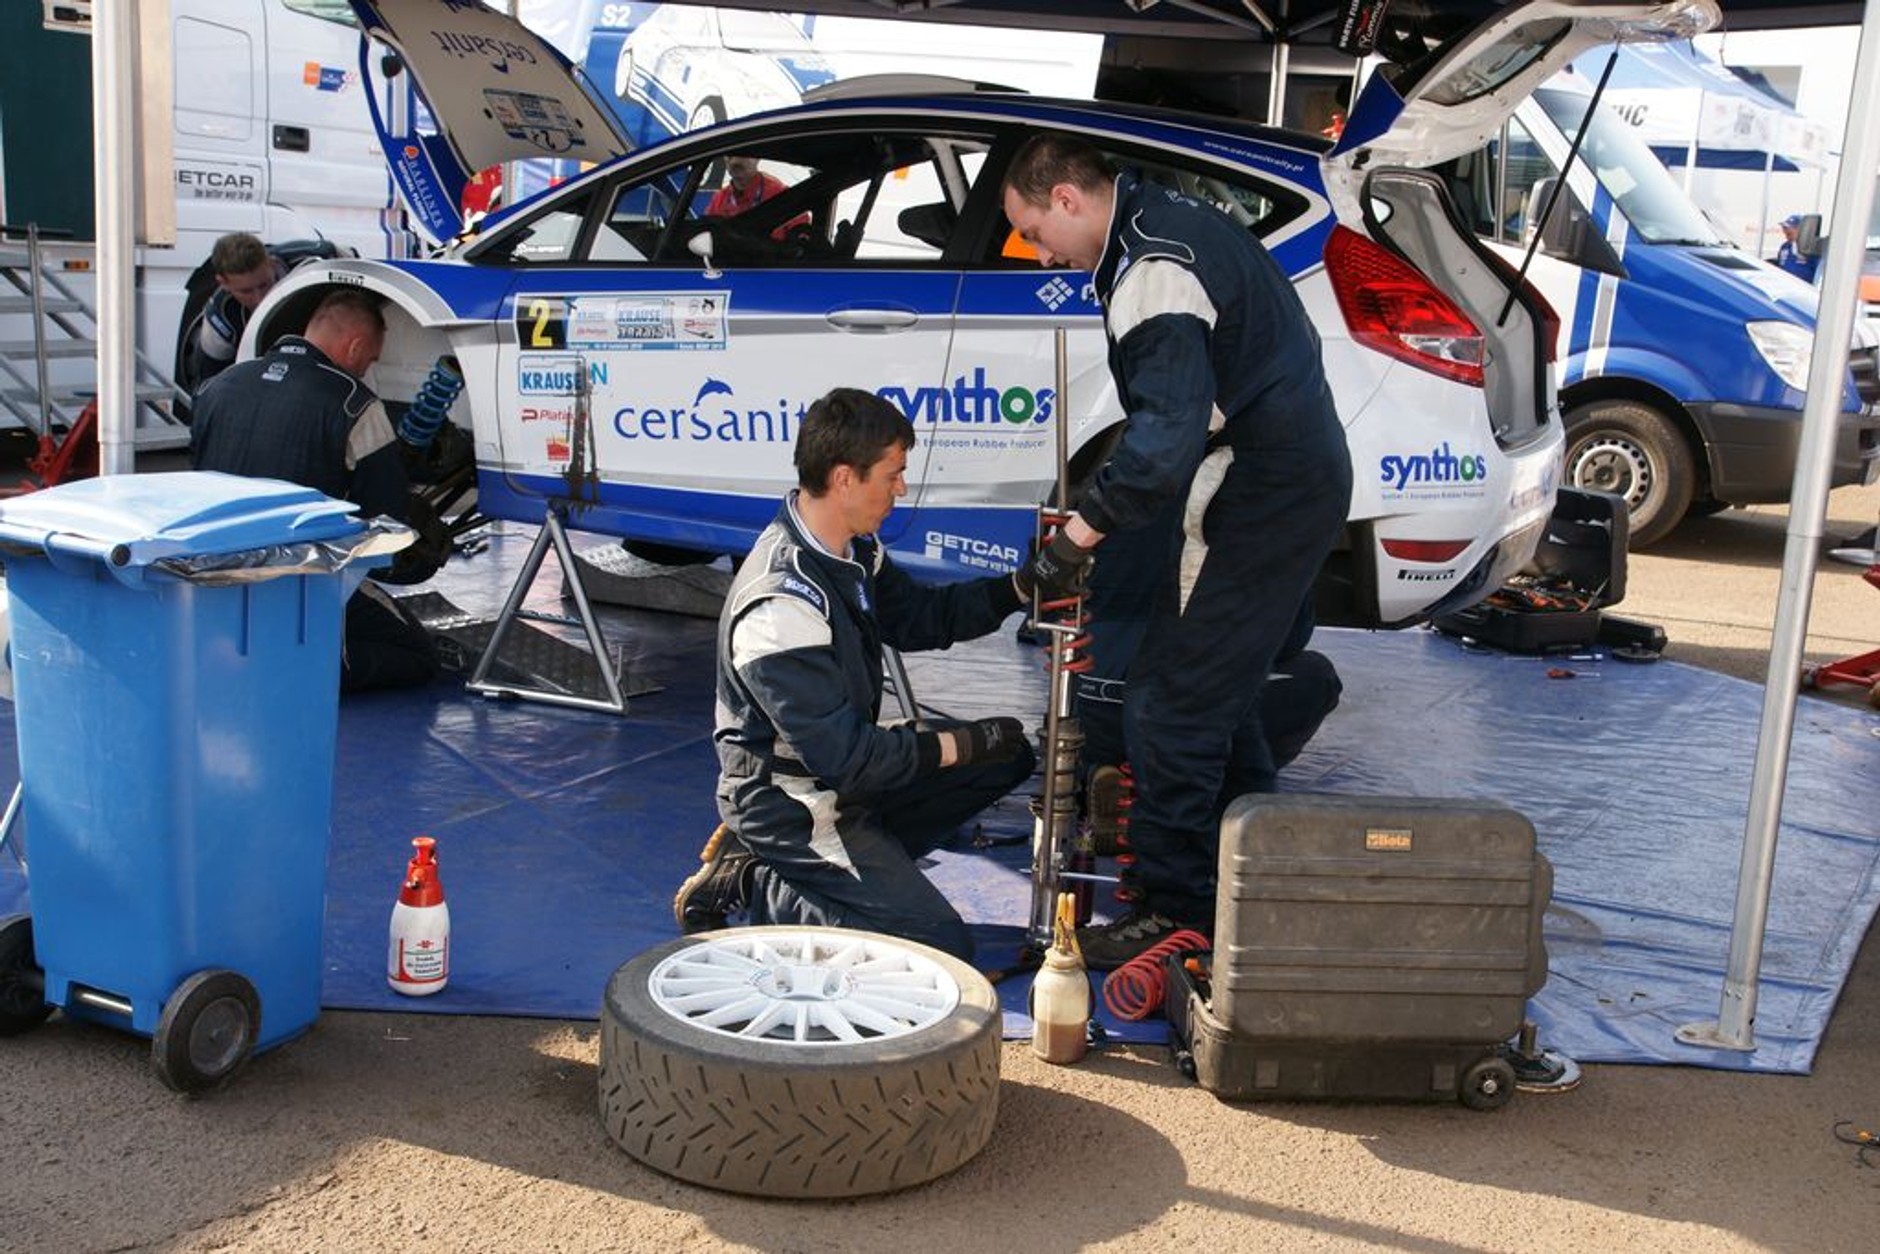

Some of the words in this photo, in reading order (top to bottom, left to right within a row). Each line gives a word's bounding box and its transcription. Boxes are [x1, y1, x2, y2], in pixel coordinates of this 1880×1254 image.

[602, 4, 631, 25] S2
[175, 169, 254, 189] ETCAR
[528, 299, 553, 347] 2
[521, 372, 583, 390] KRAUSE
[591, 362, 607, 385] N
[1380, 442, 1486, 490] synthos
[925, 530, 1019, 562] GETCAR
[1397, 568, 1455, 582] PIRELLI
